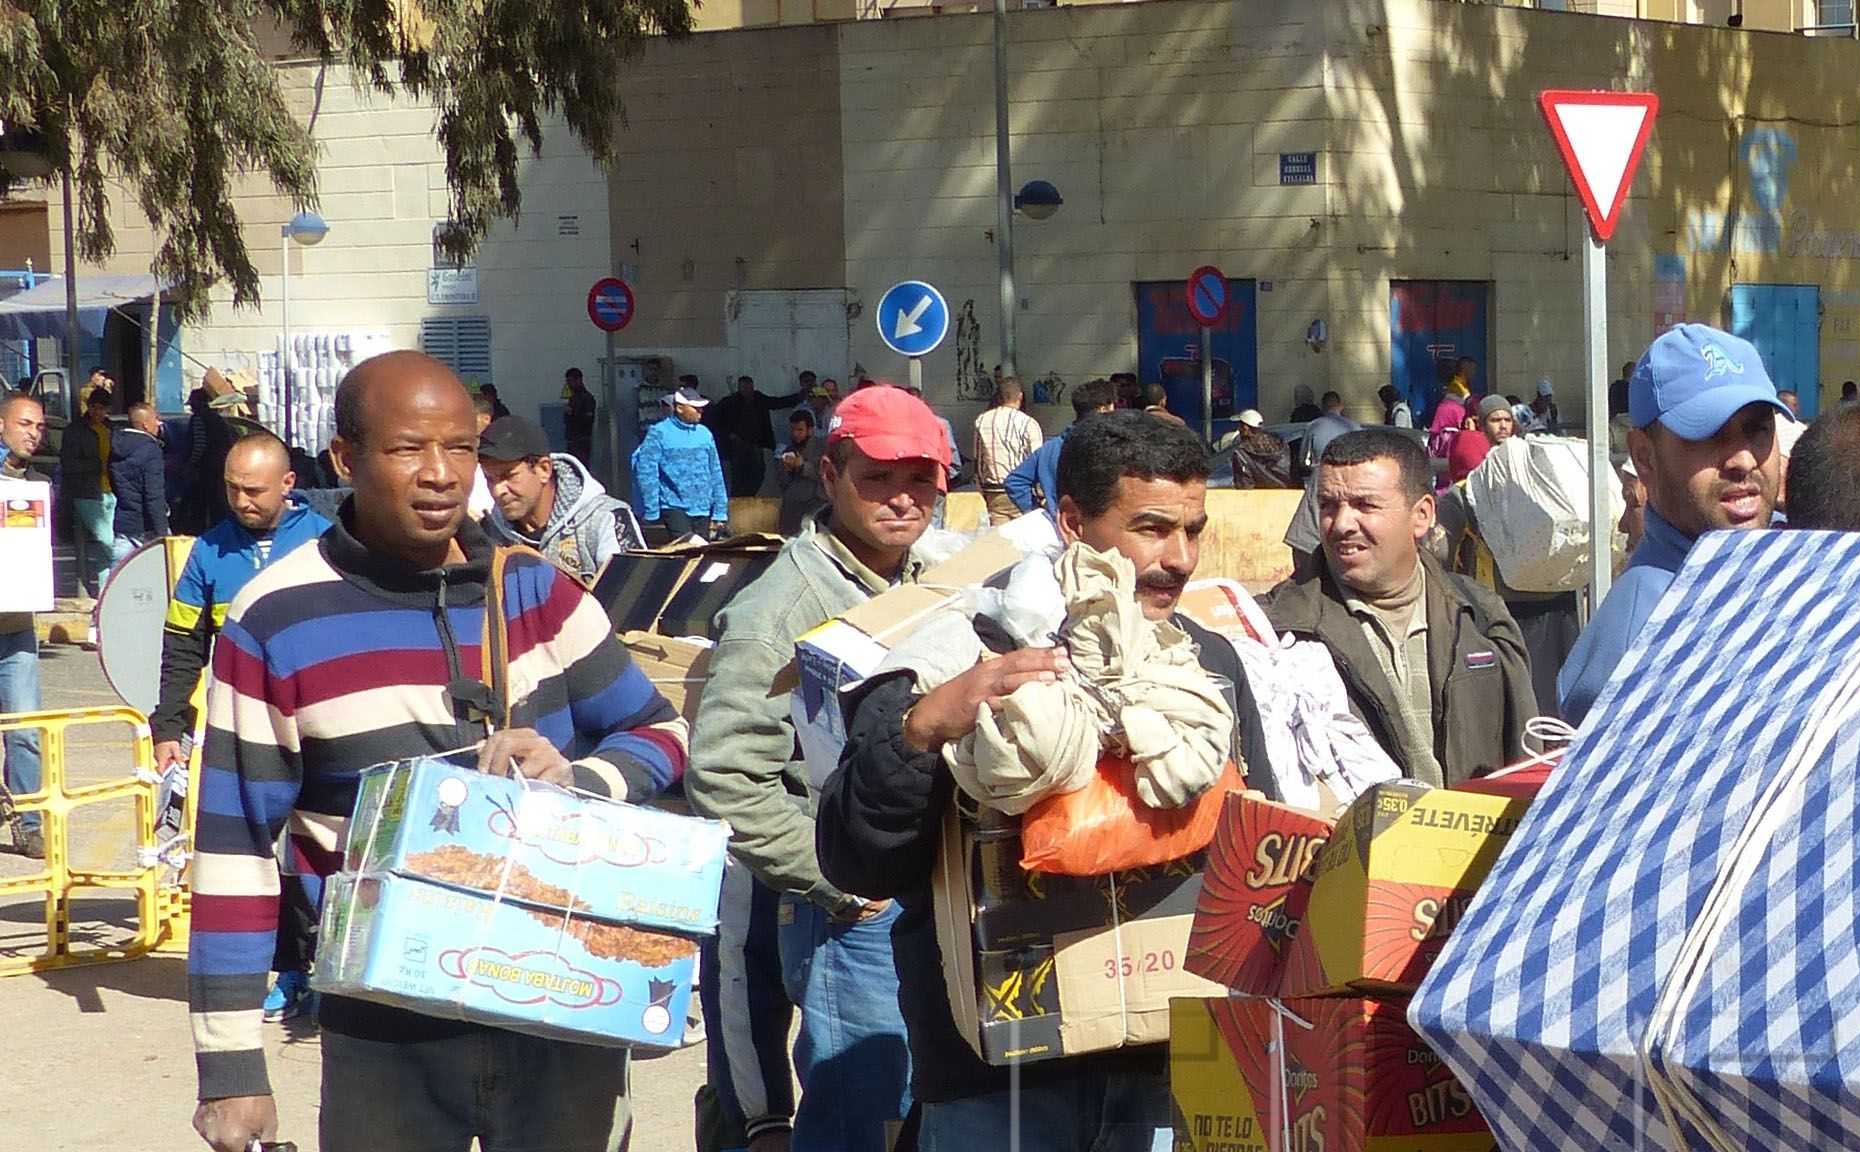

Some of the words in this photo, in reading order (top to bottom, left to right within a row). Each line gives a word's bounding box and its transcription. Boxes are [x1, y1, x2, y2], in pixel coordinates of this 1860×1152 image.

[1411, 807, 1521, 837] TRÉVETE
[1408, 1079, 1472, 1127] BITS
[1215, 1116, 1233, 1138] TE
[1235, 1118, 1253, 1140] LO
